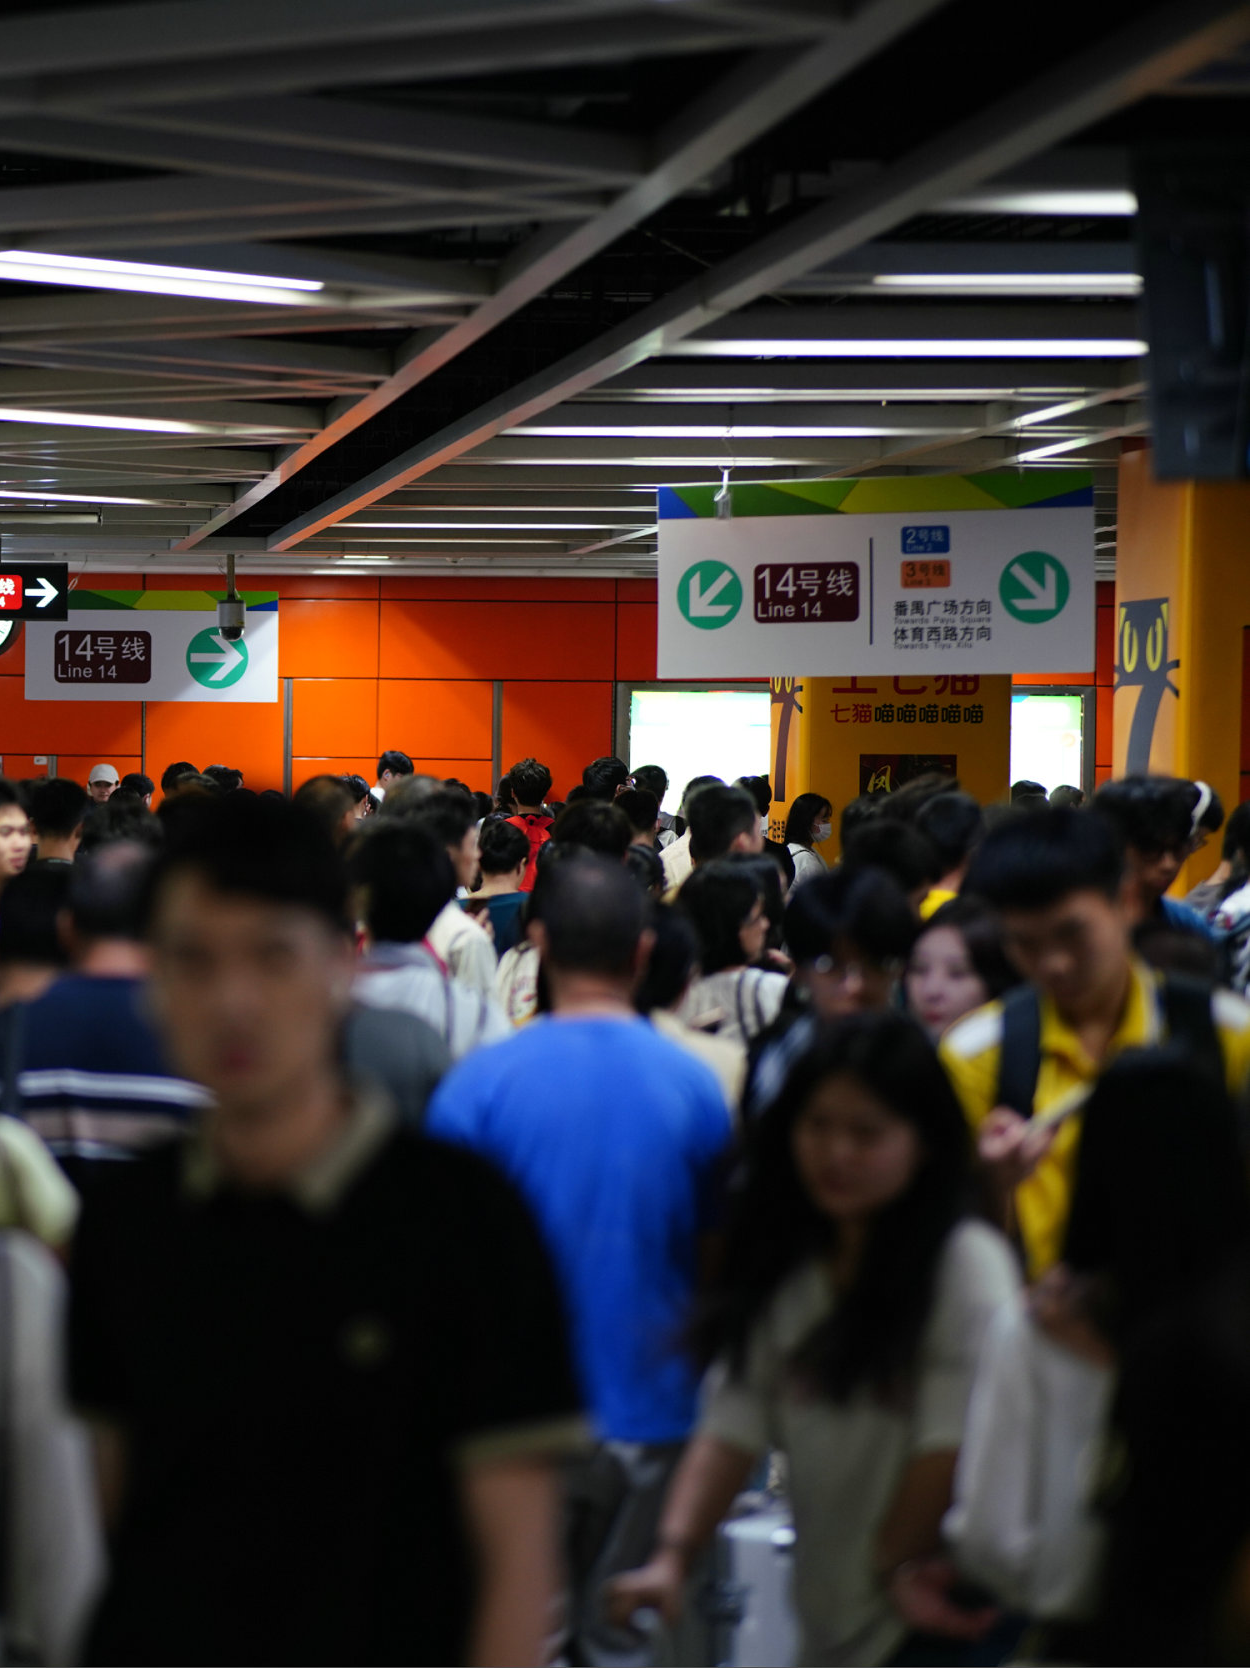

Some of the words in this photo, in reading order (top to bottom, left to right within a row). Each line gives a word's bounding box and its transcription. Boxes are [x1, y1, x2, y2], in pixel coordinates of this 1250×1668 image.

[905, 528, 945, 544] 2号线
[905, 562, 945, 577] 3号线
[757, 567, 854, 599] 14号线
[757, 601, 796, 617] Line
[800, 601, 823, 617] 14
[894, 599, 992, 616] 番禺广场方向
[893, 625, 992, 641] 体育西路方向
[57, 633, 146, 662] 14号线
[57, 664, 93, 678] Line
[97, 664, 118, 679] 14
[830, 703, 984, 724] 七猫喵喵喵喵喵
